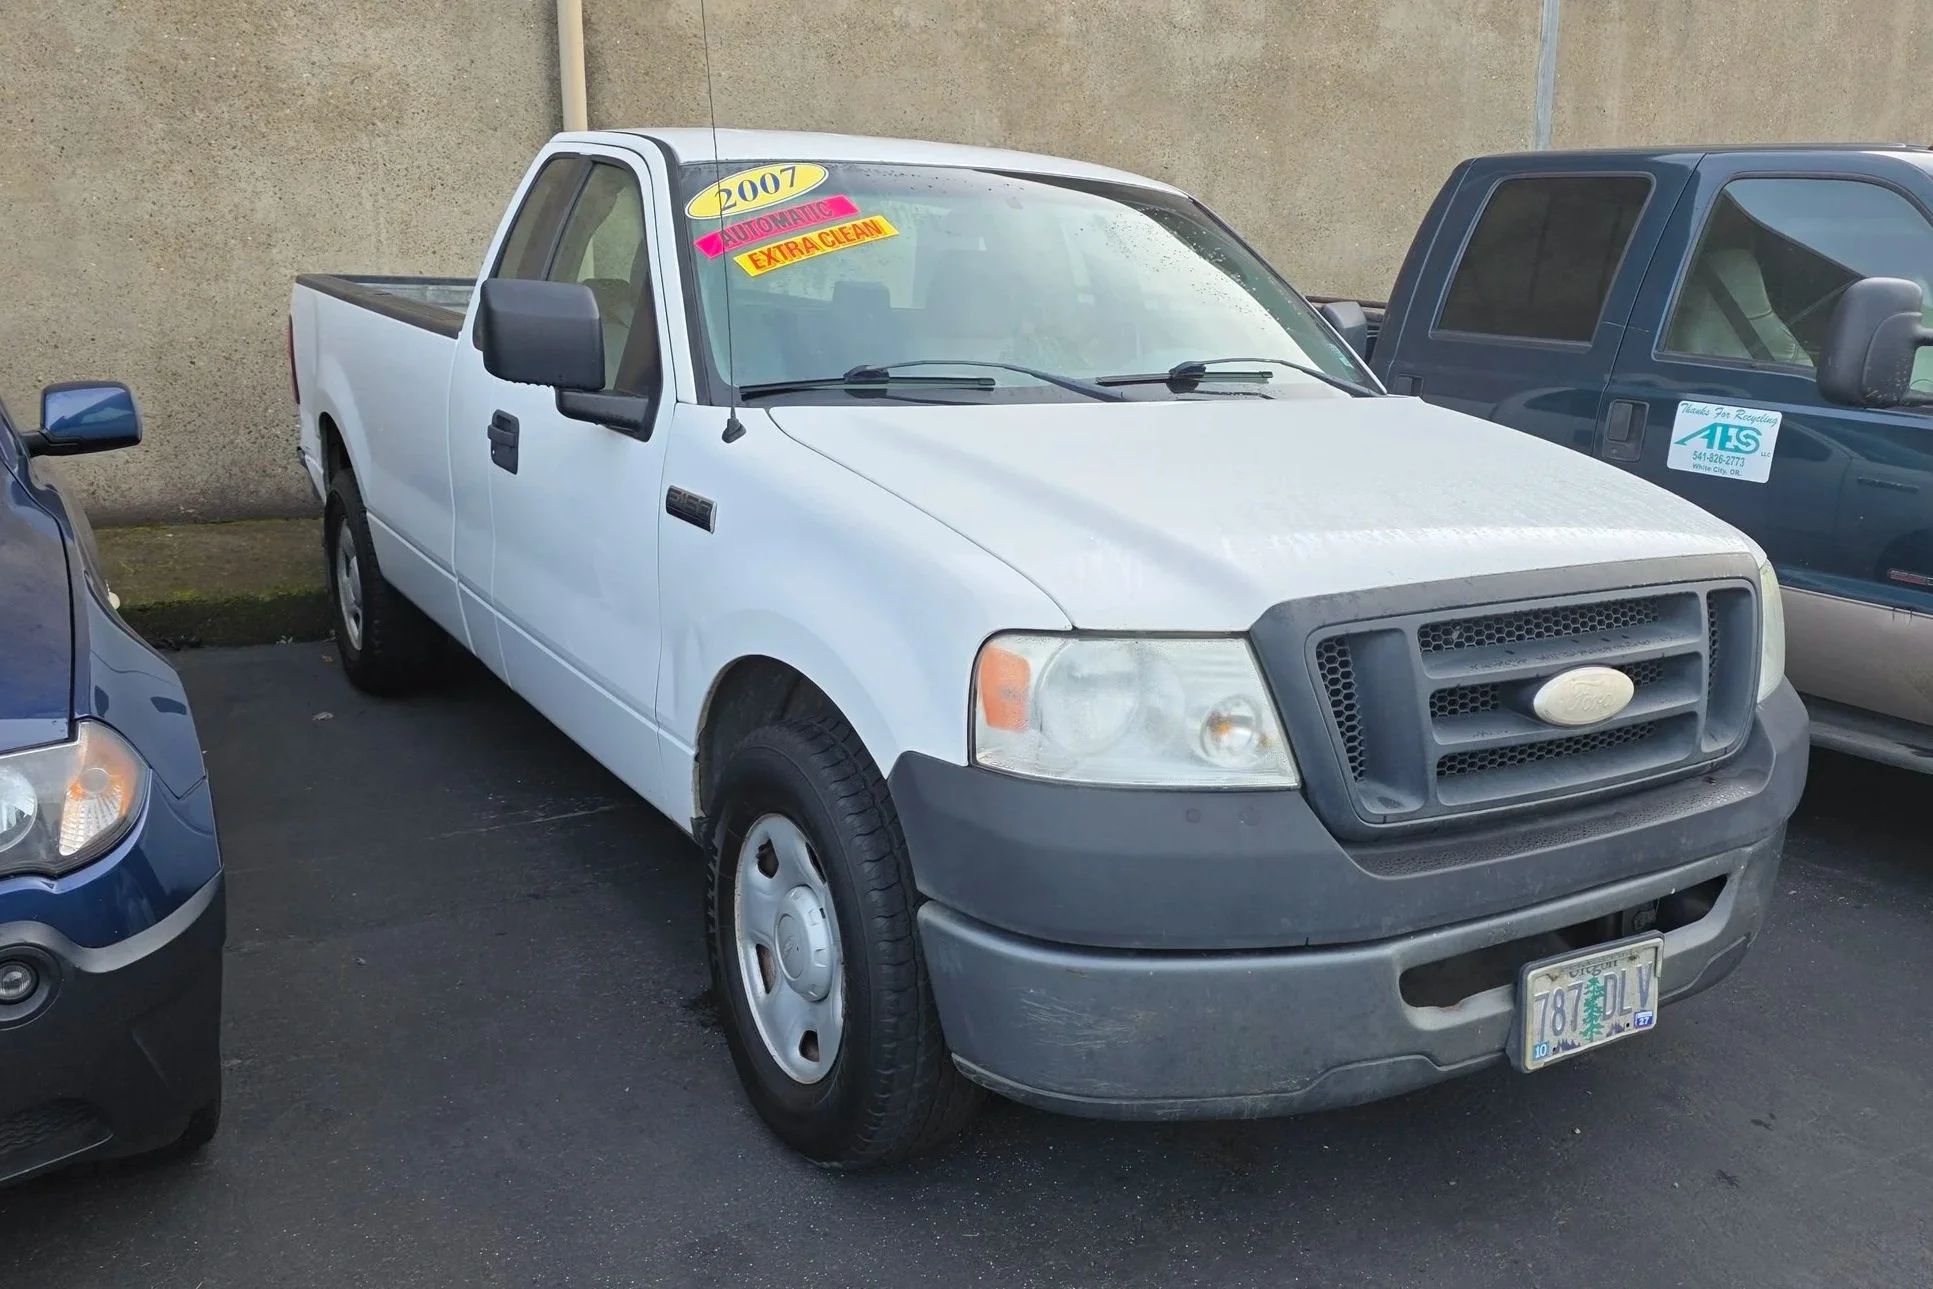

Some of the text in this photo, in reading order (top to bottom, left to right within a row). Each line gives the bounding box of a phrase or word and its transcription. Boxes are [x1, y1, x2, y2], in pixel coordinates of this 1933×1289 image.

[715, 166, 796, 211] 2007
[720, 200, 833, 248] AUTOMATIC
[747, 219, 882, 271] EXTRA CLEAN
[1680, 402, 1778, 428] Thanks For Recycling
[1692, 450, 1745, 468] 541-826-2773
[1692, 463, 1711, 472] White
[1638, 1016, 1650, 1026] 27
[1535, 1044, 1547, 1058] 10
